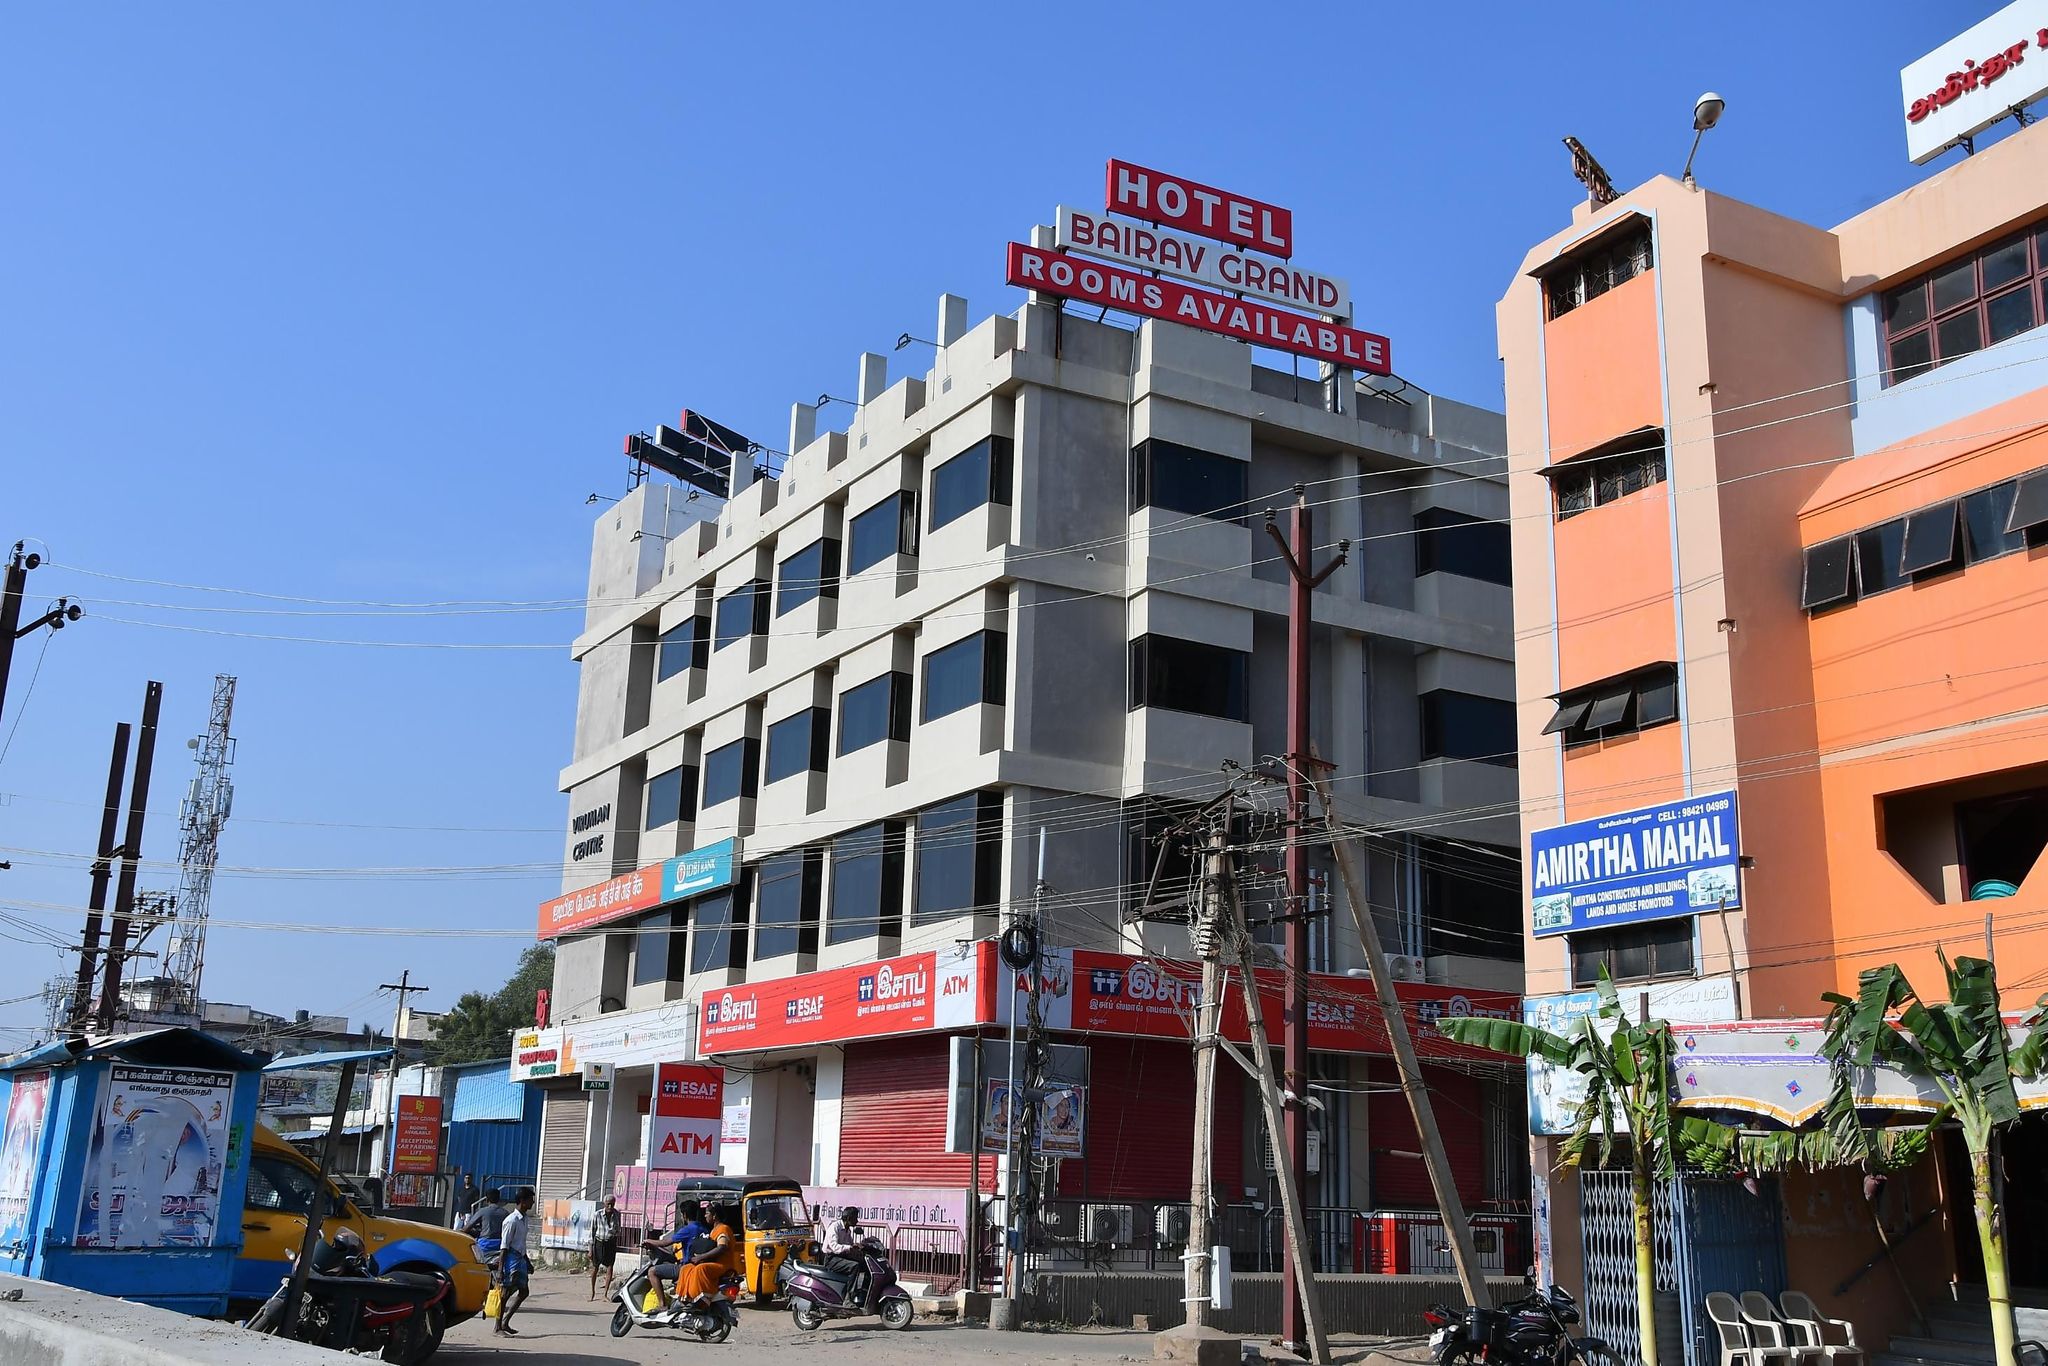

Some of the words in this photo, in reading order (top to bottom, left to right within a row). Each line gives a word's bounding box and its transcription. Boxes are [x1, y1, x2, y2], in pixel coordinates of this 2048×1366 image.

[1117, 167, 1286, 248] HOTEL
[1070, 212, 1206, 274] BAIRAV
[1218, 253, 1339, 309] GRAND
[1020, 252, 1163, 309] ROOMS
[1177, 294, 1383, 366] AVAILABLE
[1658, 810, 1677, 823] CELL
[1682, 803, 1704, 817] 98421
[1705, 799, 1729, 813] 04989
[572, 834, 604, 862] CENTRE
[1535, 833, 1638, 889] AMIRTHA
[1642, 815, 1731, 870] MAHAL
[686, 861, 701, 877] IDBI
[700, 857, 716, 873] BANK
[1572, 893, 1597, 907] AMIRTHA
[1597, 886, 1641, 903] CONSTRUCTION
[1641, 884, 1654, 896] AND
[1654, 878, 1688, 894] BUILDINGS,
[1586, 906, 1605, 919] LANDS
[1605, 904, 1617, 915] AND
[1617, 900, 1638, 914] HOUSE
[1637, 895, 1674, 911] PROMOTORS
[942, 974, 969, 996] ATM
[1015, 973, 1058, 995] AM
[797, 995, 824, 1017] ESAF
[1307, 1001, 1355, 1023] ESAF
[129, 1069, 173, 1082] கண்ணீர்
[174, 1072, 215, 1085] அஞ்சலி
[590, 1081, 605, 1089] ATM
[680, 1081, 718, 1096] ESAF
[660, 1131, 713, 1155] ATM
